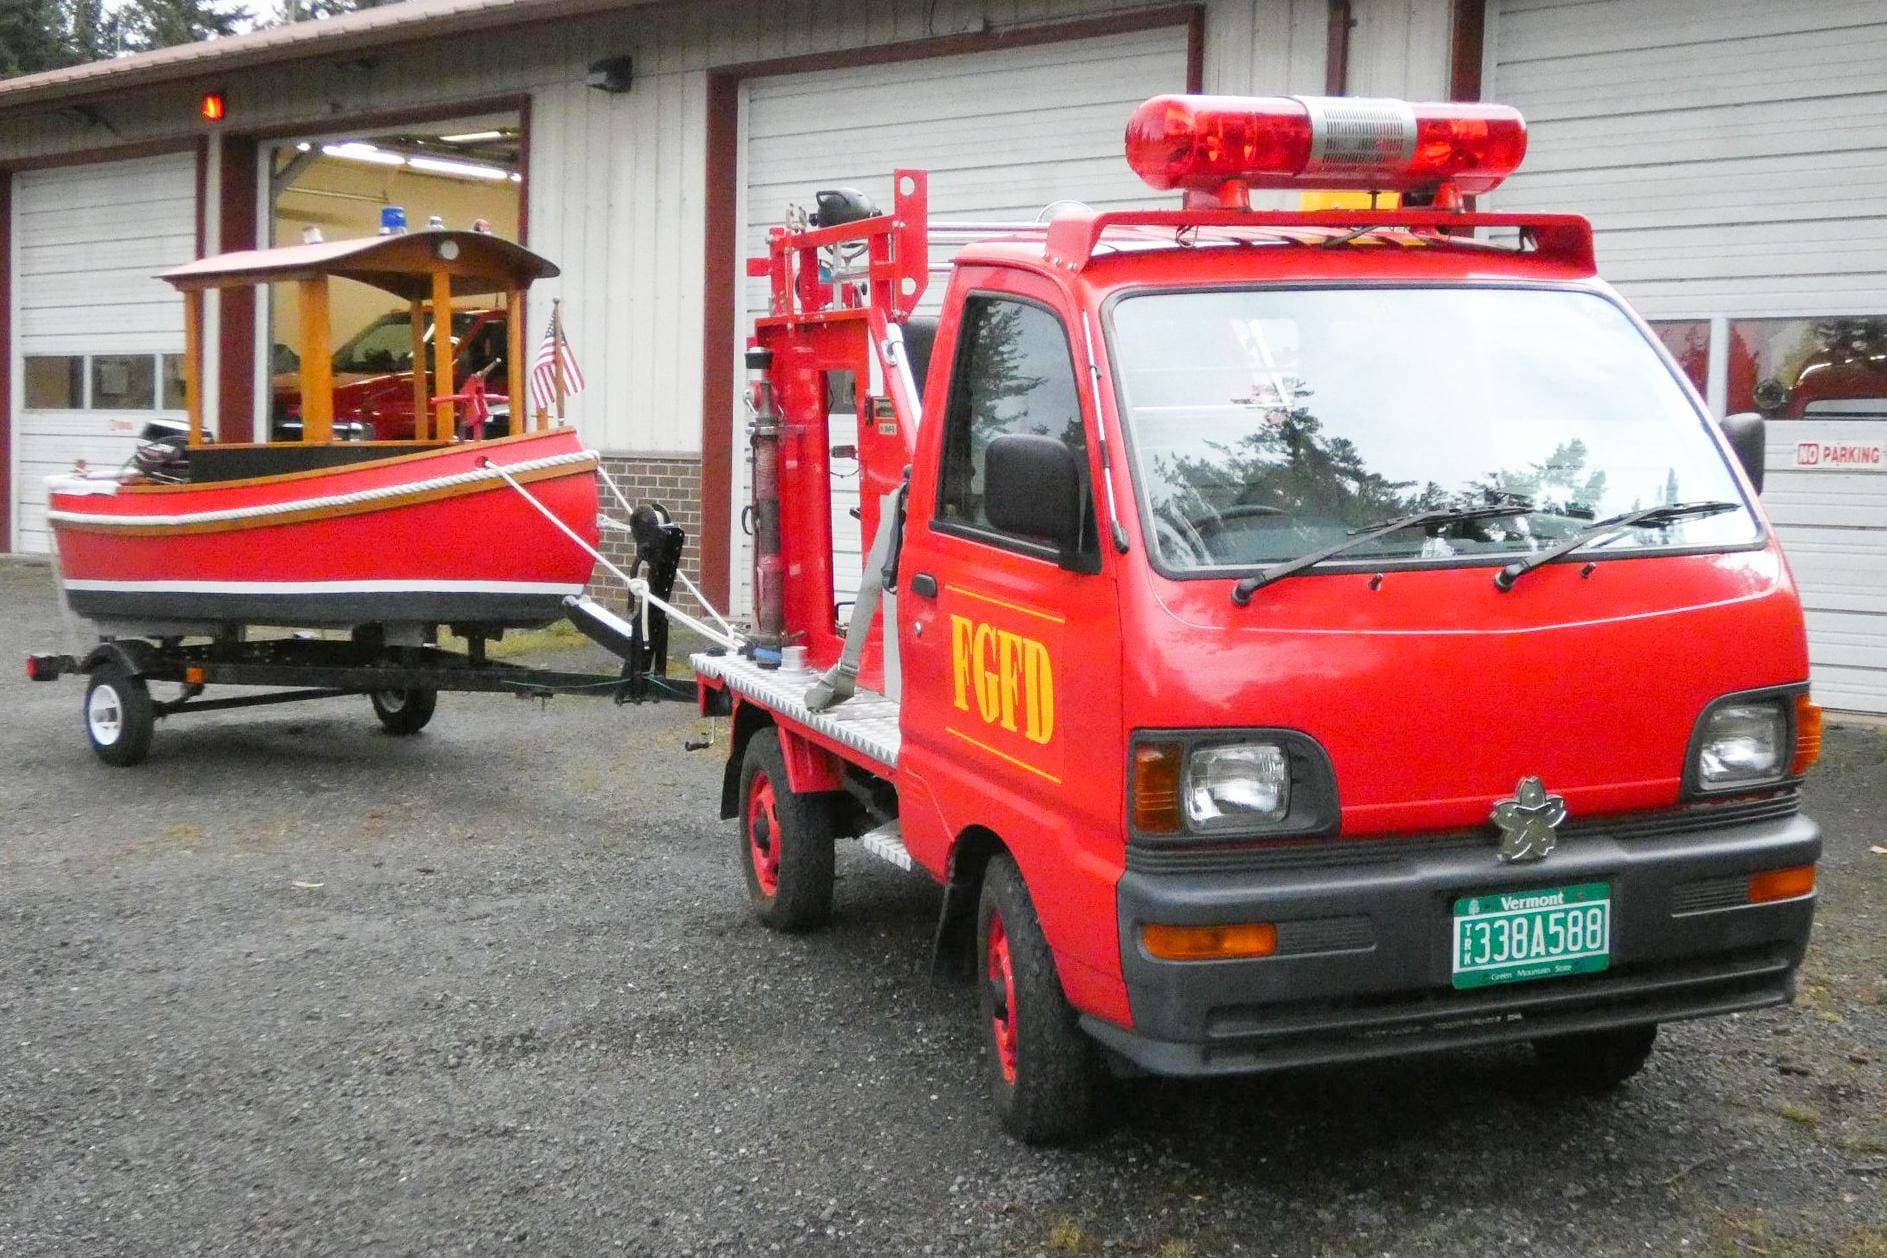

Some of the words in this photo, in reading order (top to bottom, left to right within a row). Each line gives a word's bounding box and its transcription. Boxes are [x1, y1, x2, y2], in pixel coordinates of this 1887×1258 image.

[1798, 443, 1819, 465] NO
[1823, 446, 1880, 464] PARKING
[950, 614, 1054, 745] FGFD
[1501, 890, 1565, 911] Vermont
[1464, 923, 1472, 965] TRK
[1474, 908, 1603, 964] 338A588
[1517, 967, 1551, 977] Mountain
